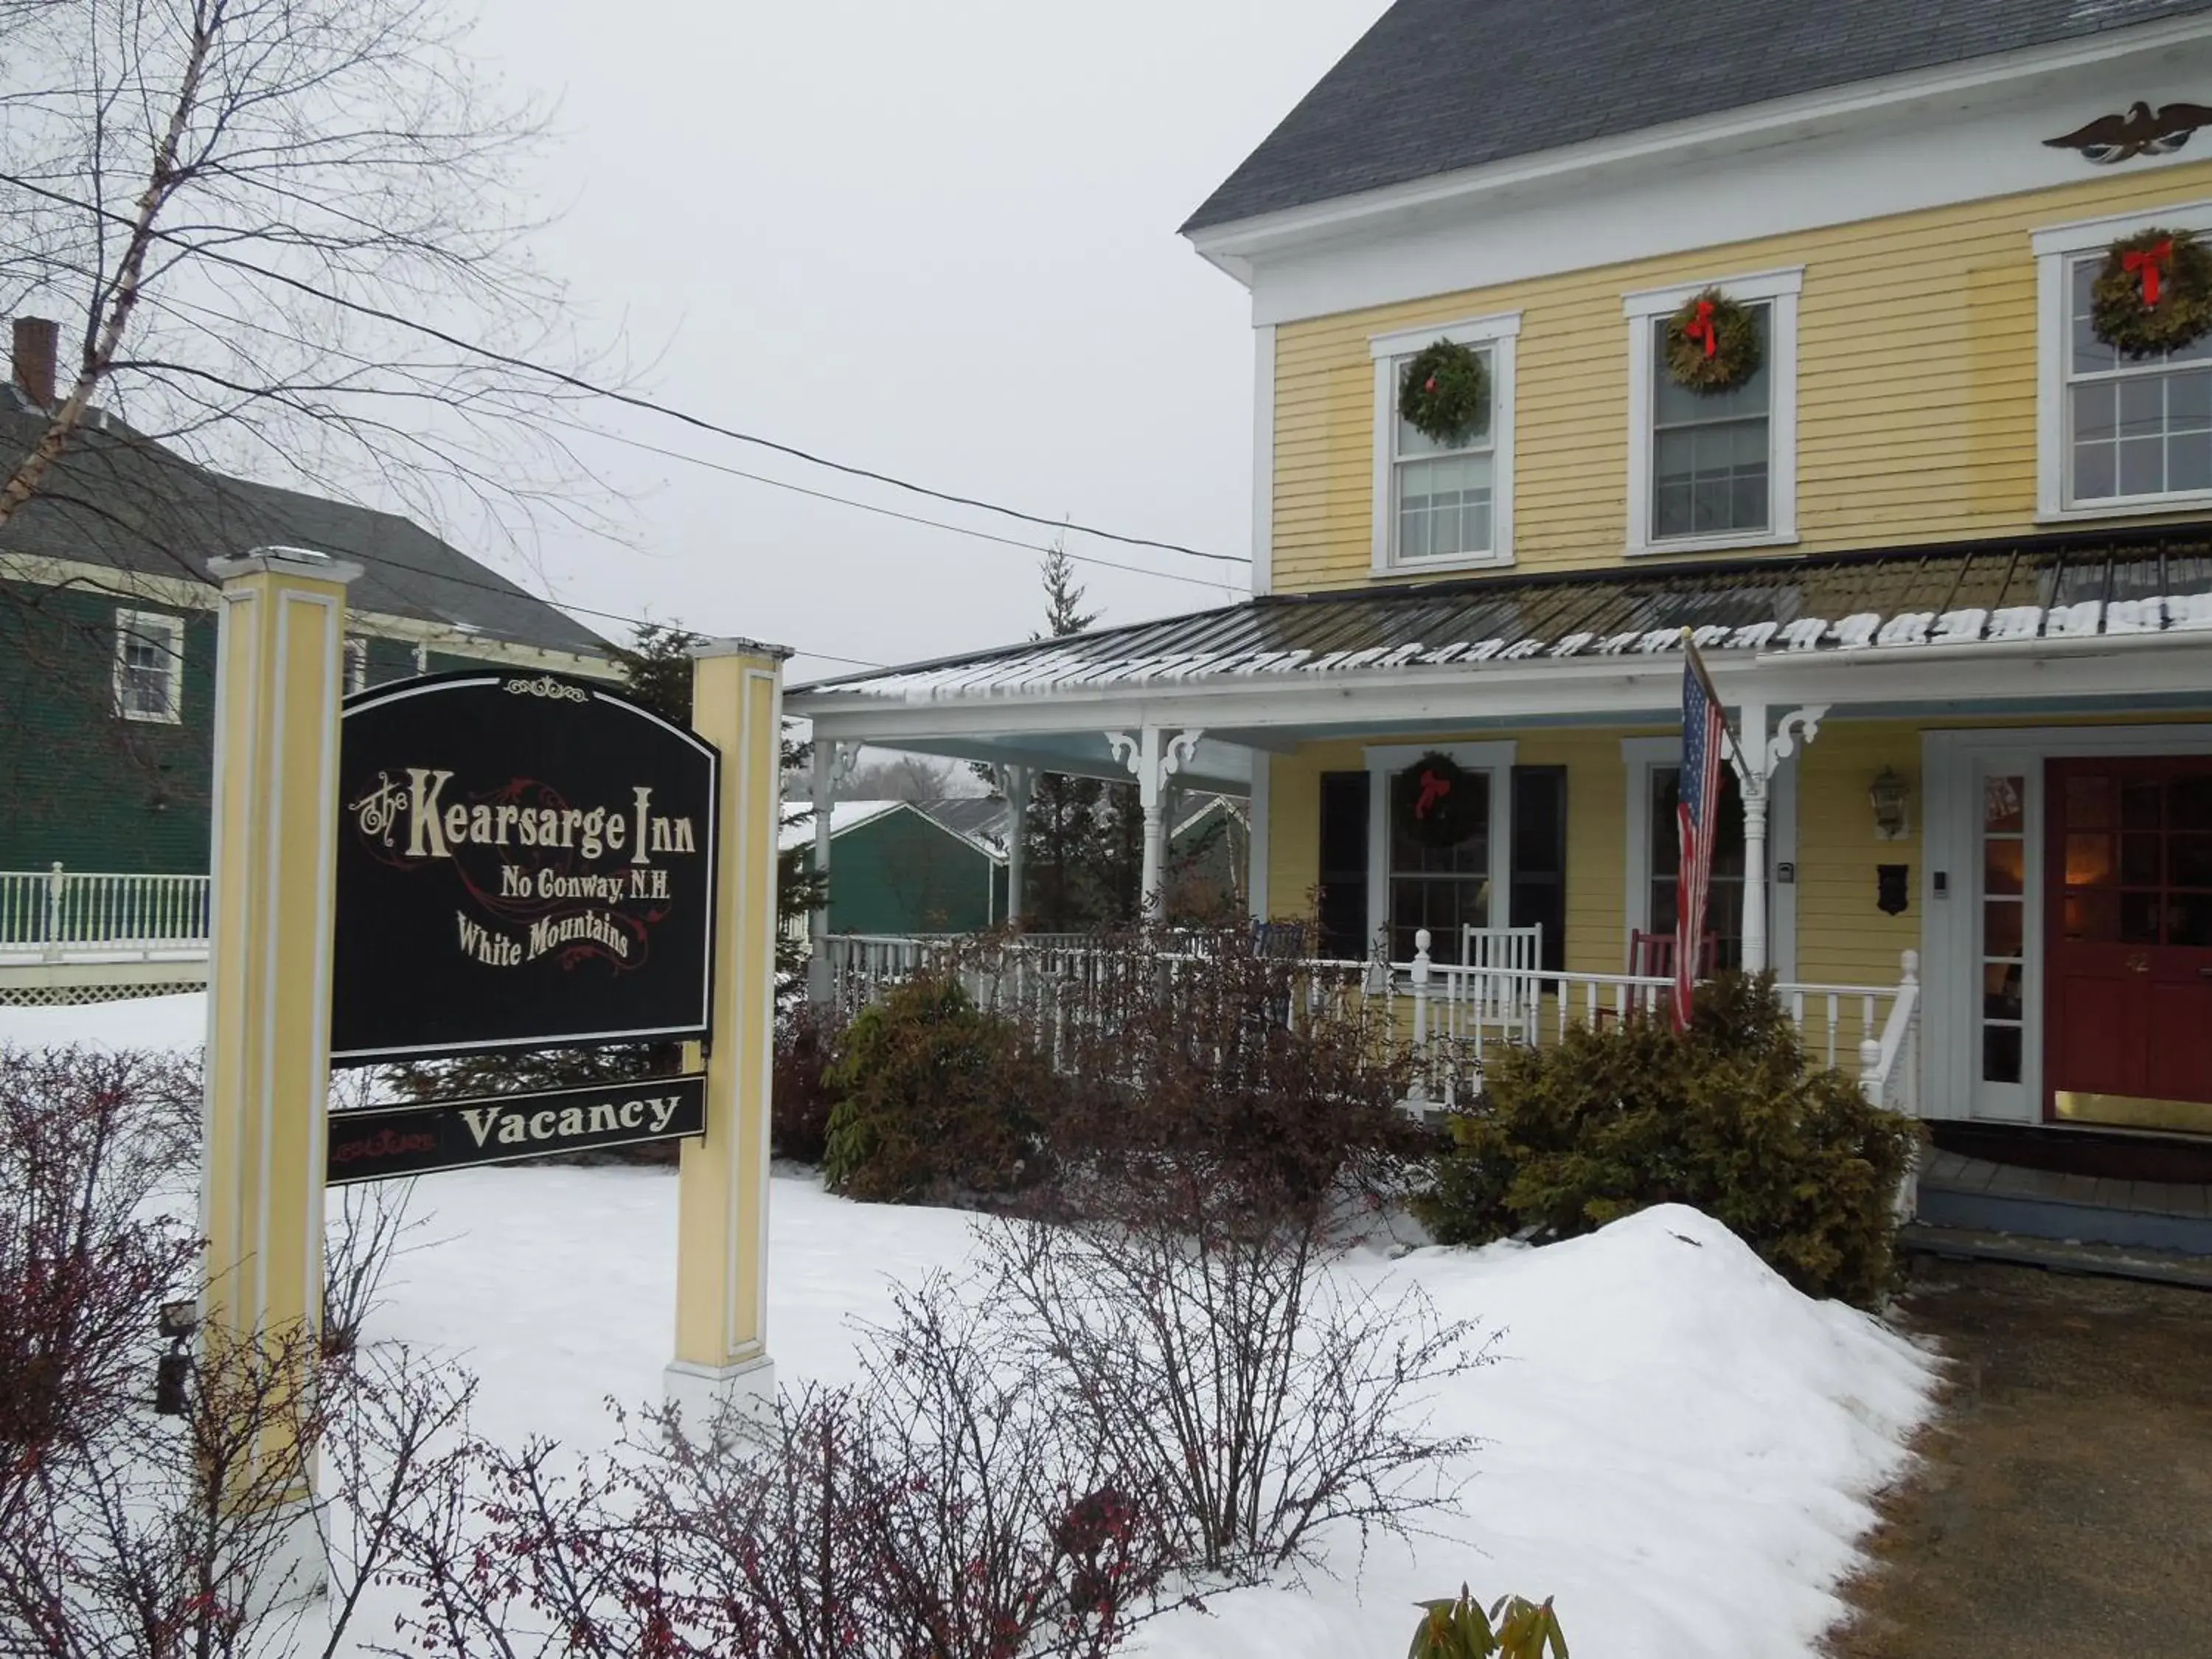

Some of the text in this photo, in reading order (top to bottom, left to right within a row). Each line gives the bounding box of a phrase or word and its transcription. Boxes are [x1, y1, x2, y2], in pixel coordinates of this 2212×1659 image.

[348, 768, 695, 864] The Kearsarge Inn
[501, 865, 532, 897] No
[538, 868, 623, 904] Conway,
[457, 909, 628, 966] White Mountains
[460, 1096, 681, 1148] Vacancy
